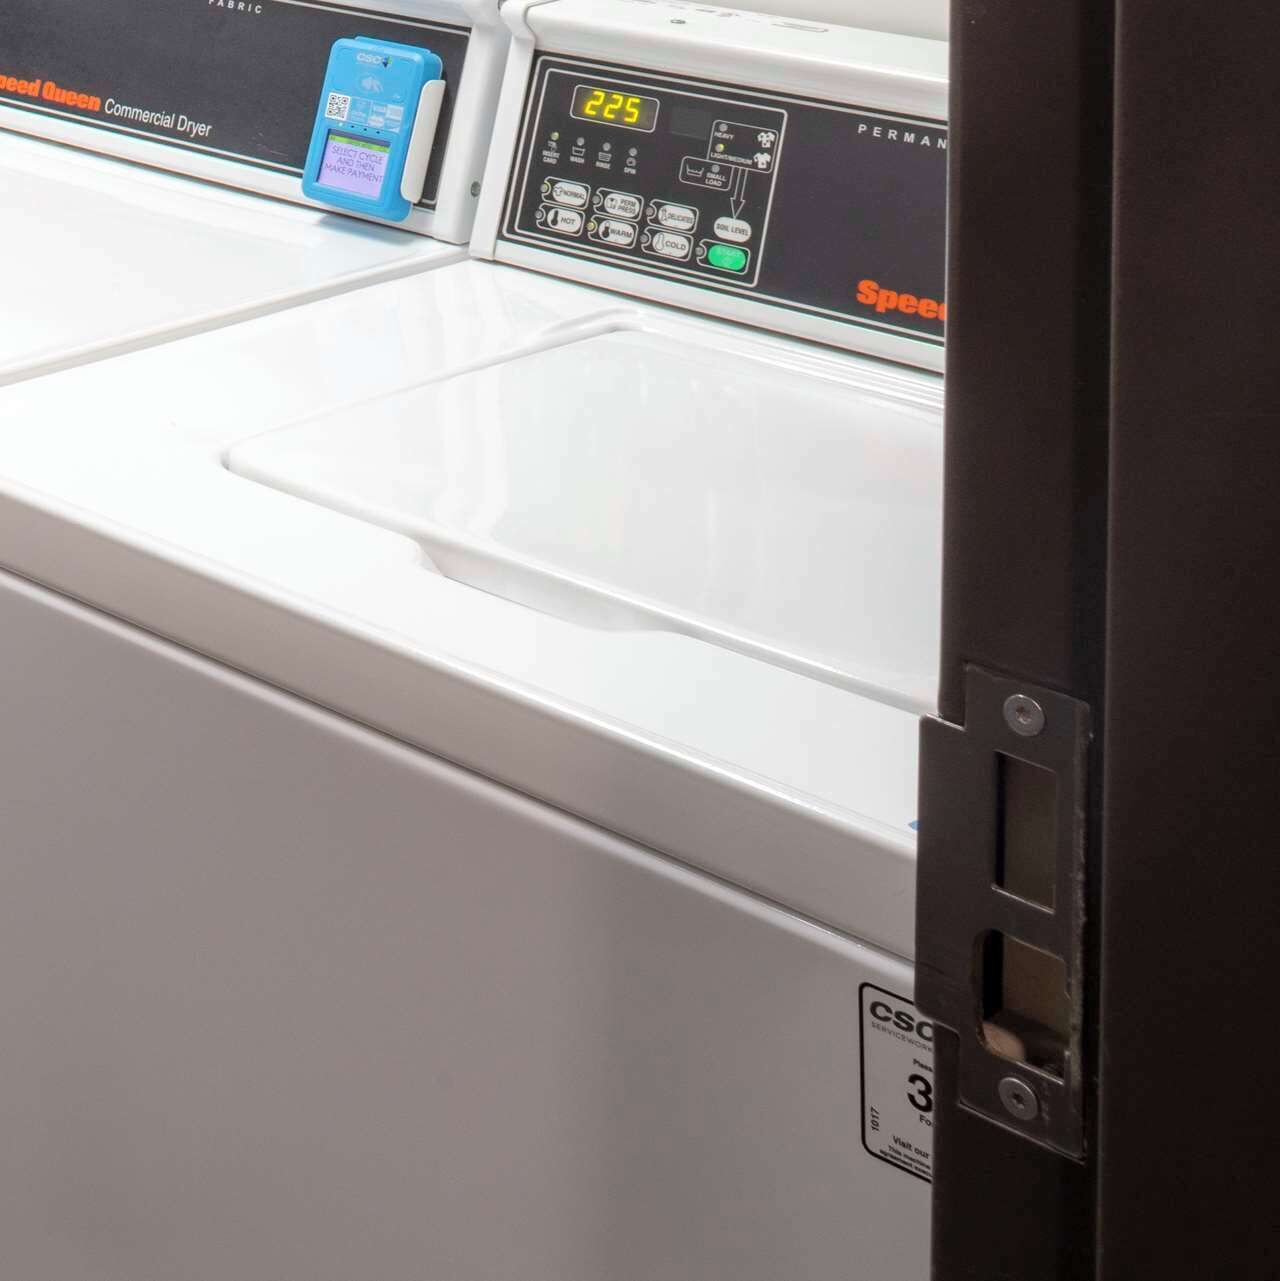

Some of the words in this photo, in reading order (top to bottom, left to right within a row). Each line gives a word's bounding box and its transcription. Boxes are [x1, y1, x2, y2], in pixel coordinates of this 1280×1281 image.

[41, 80, 101, 112] Queen
[104, 98, 175, 129] Commercial
[177, 115, 212, 137] Dryer
[584, 90, 640, 123] 225
[714, 132, 734, 140] HEAVY
[332, 145, 357, 158] SELECT
[359, 151, 384, 165] CYCLE
[706, 172, 726, 181] SMALL
[706, 178, 722, 186] LOAD
[561, 214, 576, 224] HOT
[610, 228, 632, 238] WARM
[665, 240, 686, 251] COLD
[870, 1001, 933, 1042] CSC
